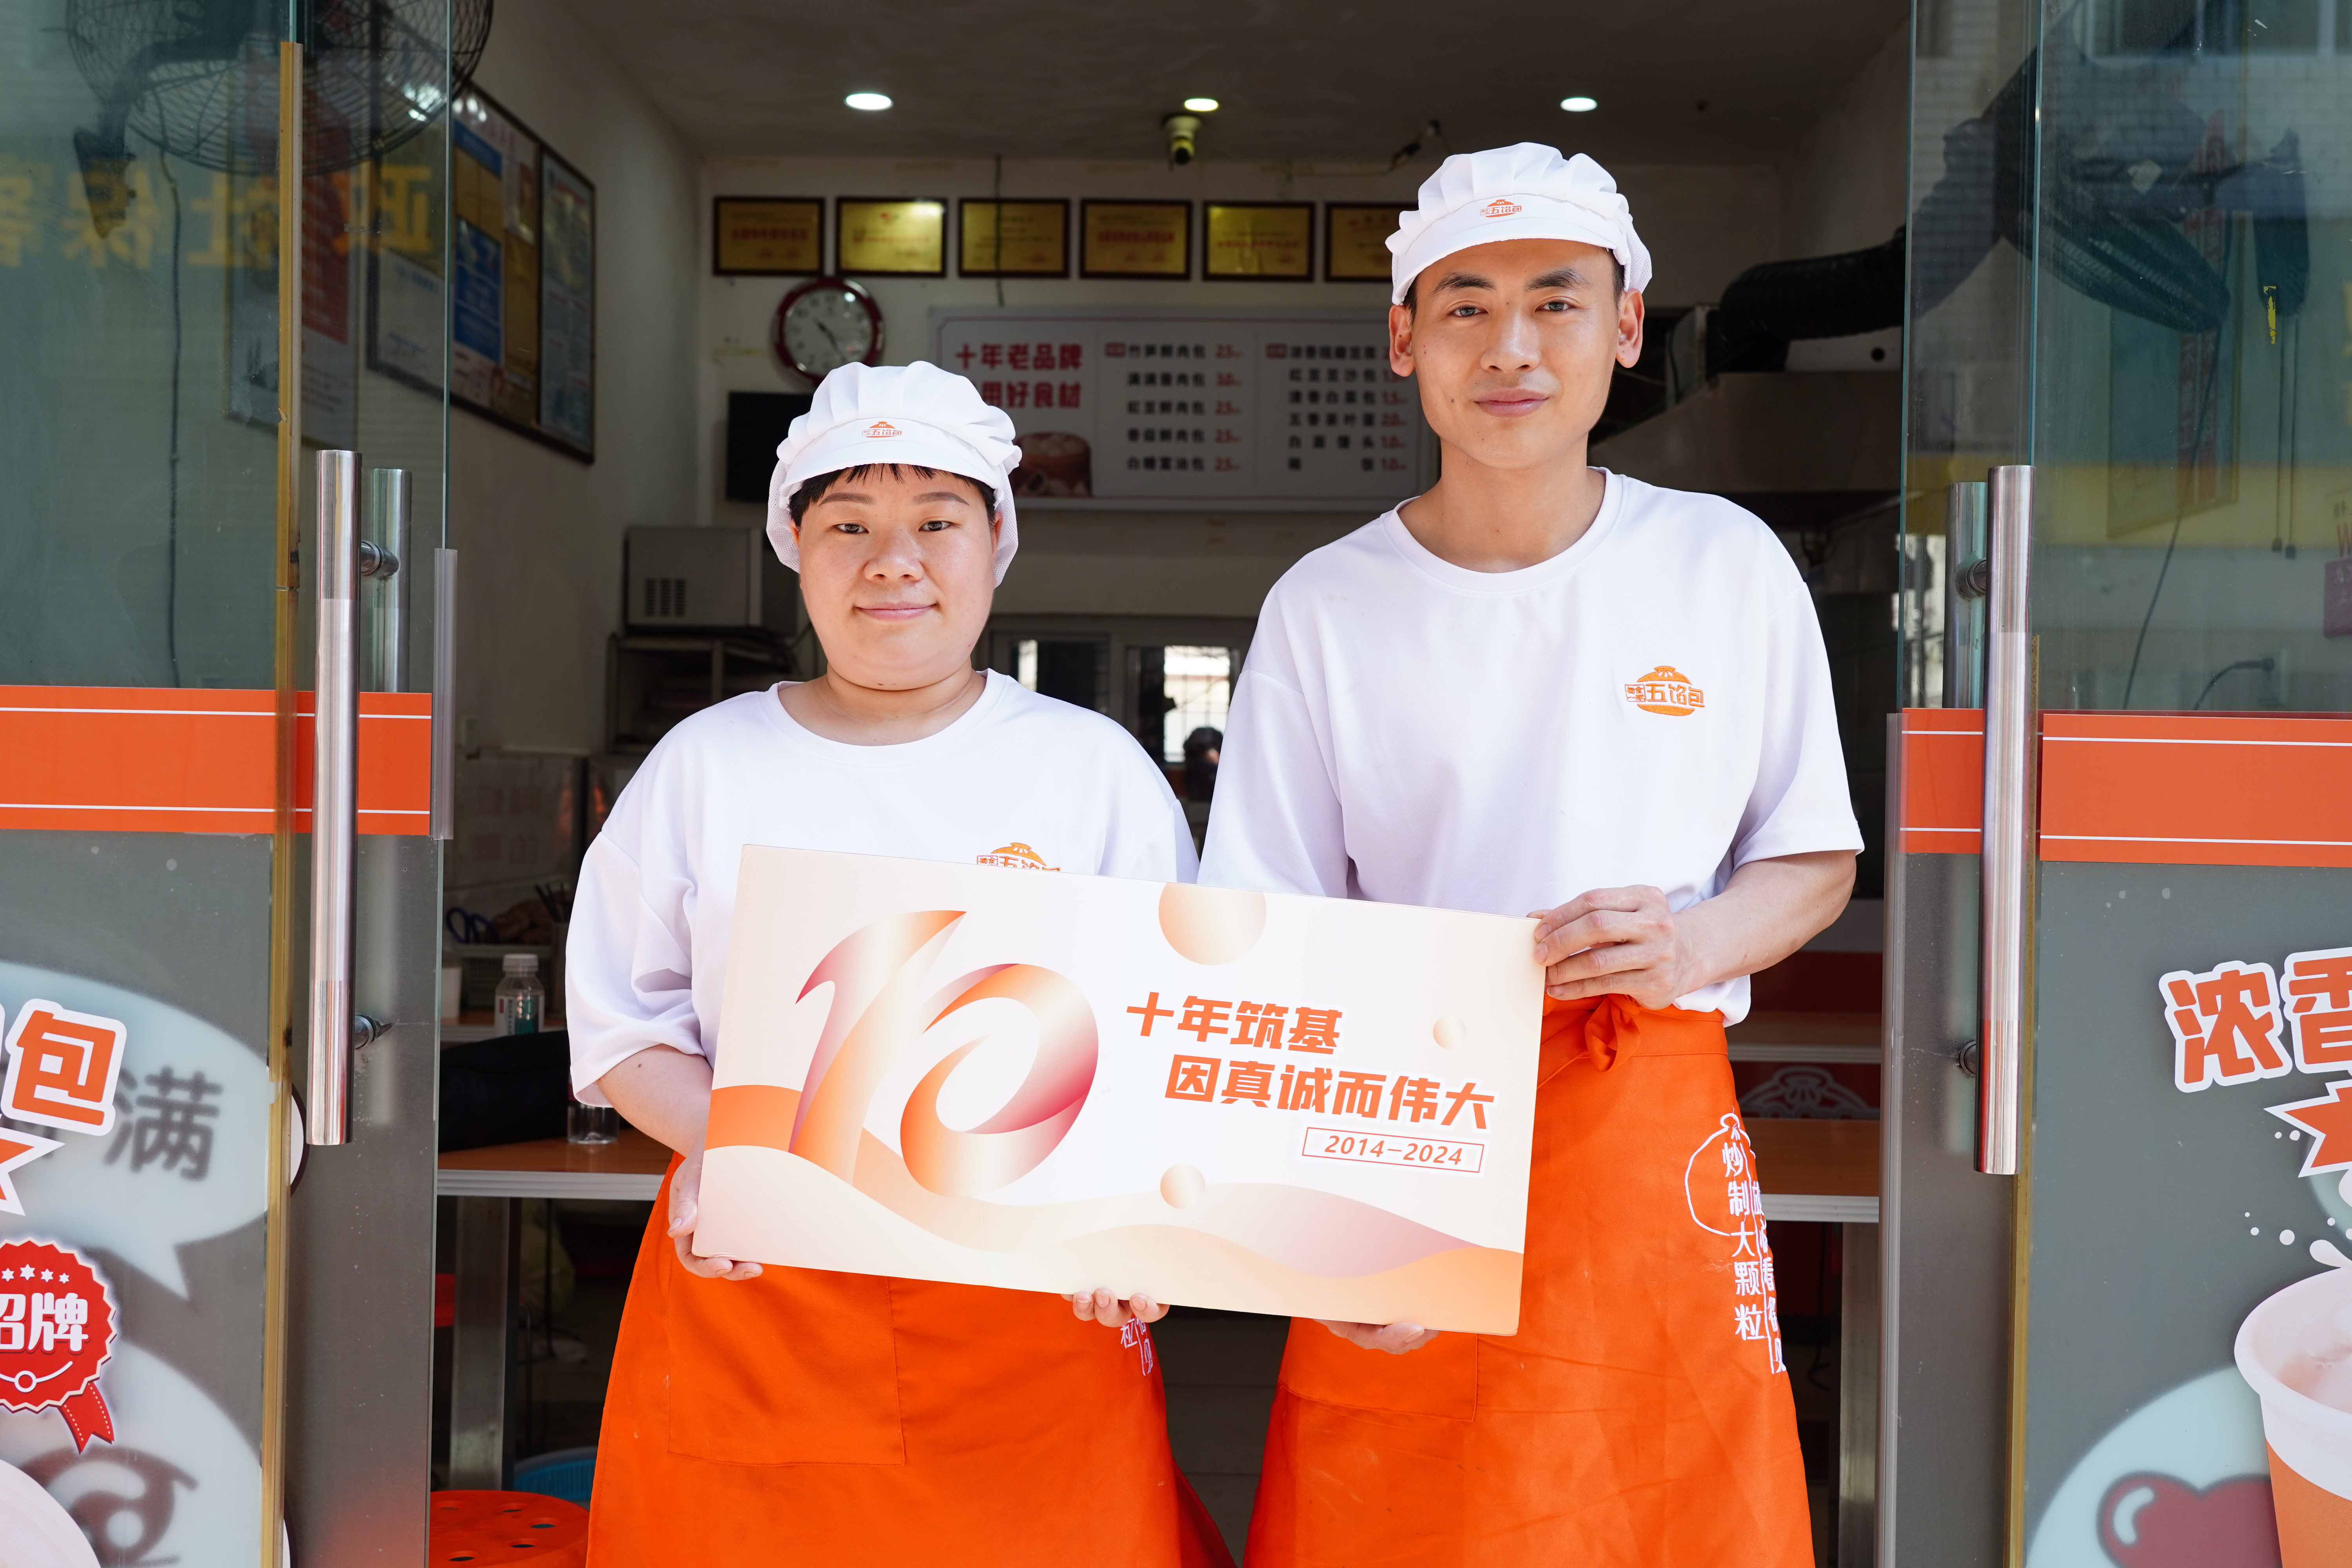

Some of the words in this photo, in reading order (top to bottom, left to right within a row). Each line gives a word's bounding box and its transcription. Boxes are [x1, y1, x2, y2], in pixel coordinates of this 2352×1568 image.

[1490, 205, 1522, 214] 五馅包
[955, 343, 1082, 370] 十年老品牌
[973, 381, 1081, 408] 用好食材
[1645, 683, 1705, 708] 五馅包
[1126, 991, 1343, 1055] 十年筑基
[9, 1005, 120, 1130] 包
[789, 910, 1099, 1197] 10
[1165, 1054, 1495, 1129] 因真诚而伟大
[103, 1065, 222, 1182] 满
[1324, 1135, 1463, 1165] 2014-2024
